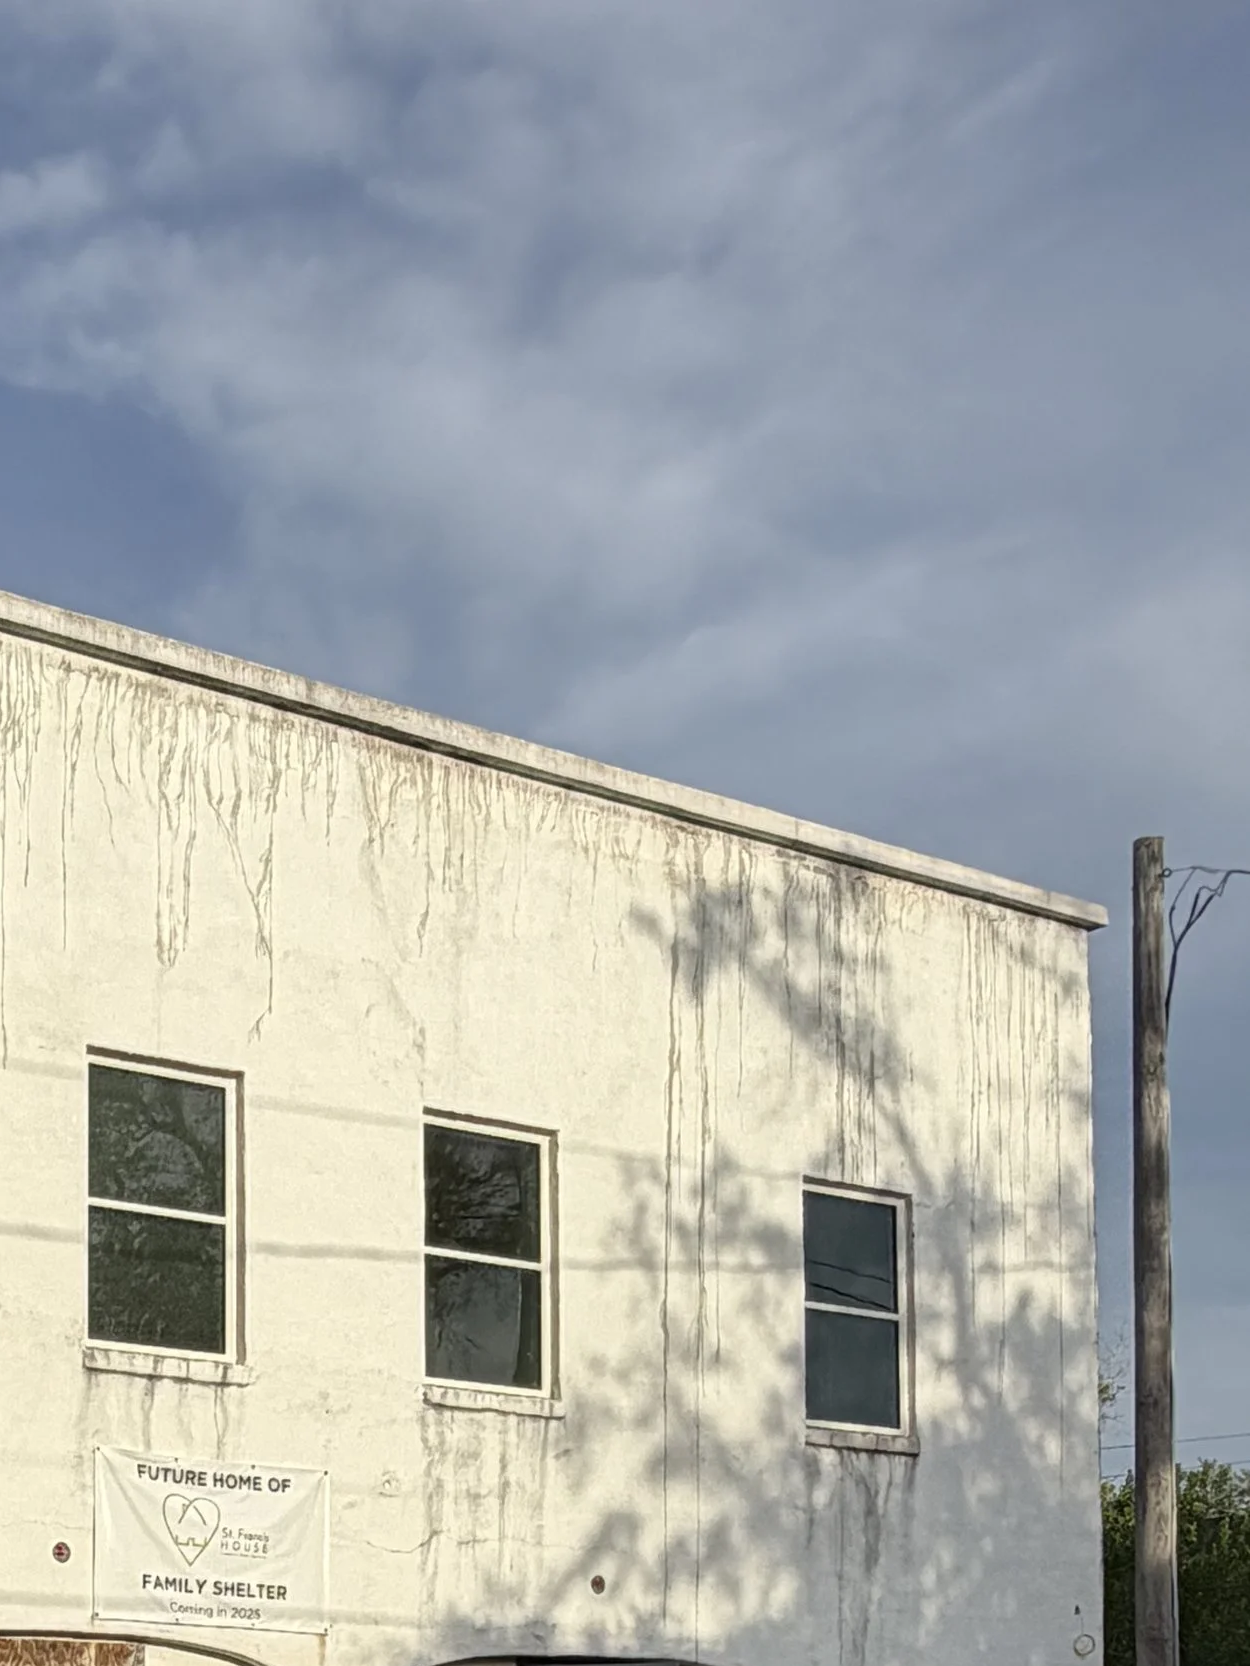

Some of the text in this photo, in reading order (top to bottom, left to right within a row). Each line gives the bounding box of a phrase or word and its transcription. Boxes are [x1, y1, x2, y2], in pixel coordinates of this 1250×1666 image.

[137, 1463, 291, 1493] FUTURE HOME OF
[220, 1540, 268, 1554] HOUSE
[142, 1574, 287, 1600] FAMILY SHELTER
[170, 1602, 261, 1620] Coming in 2025
